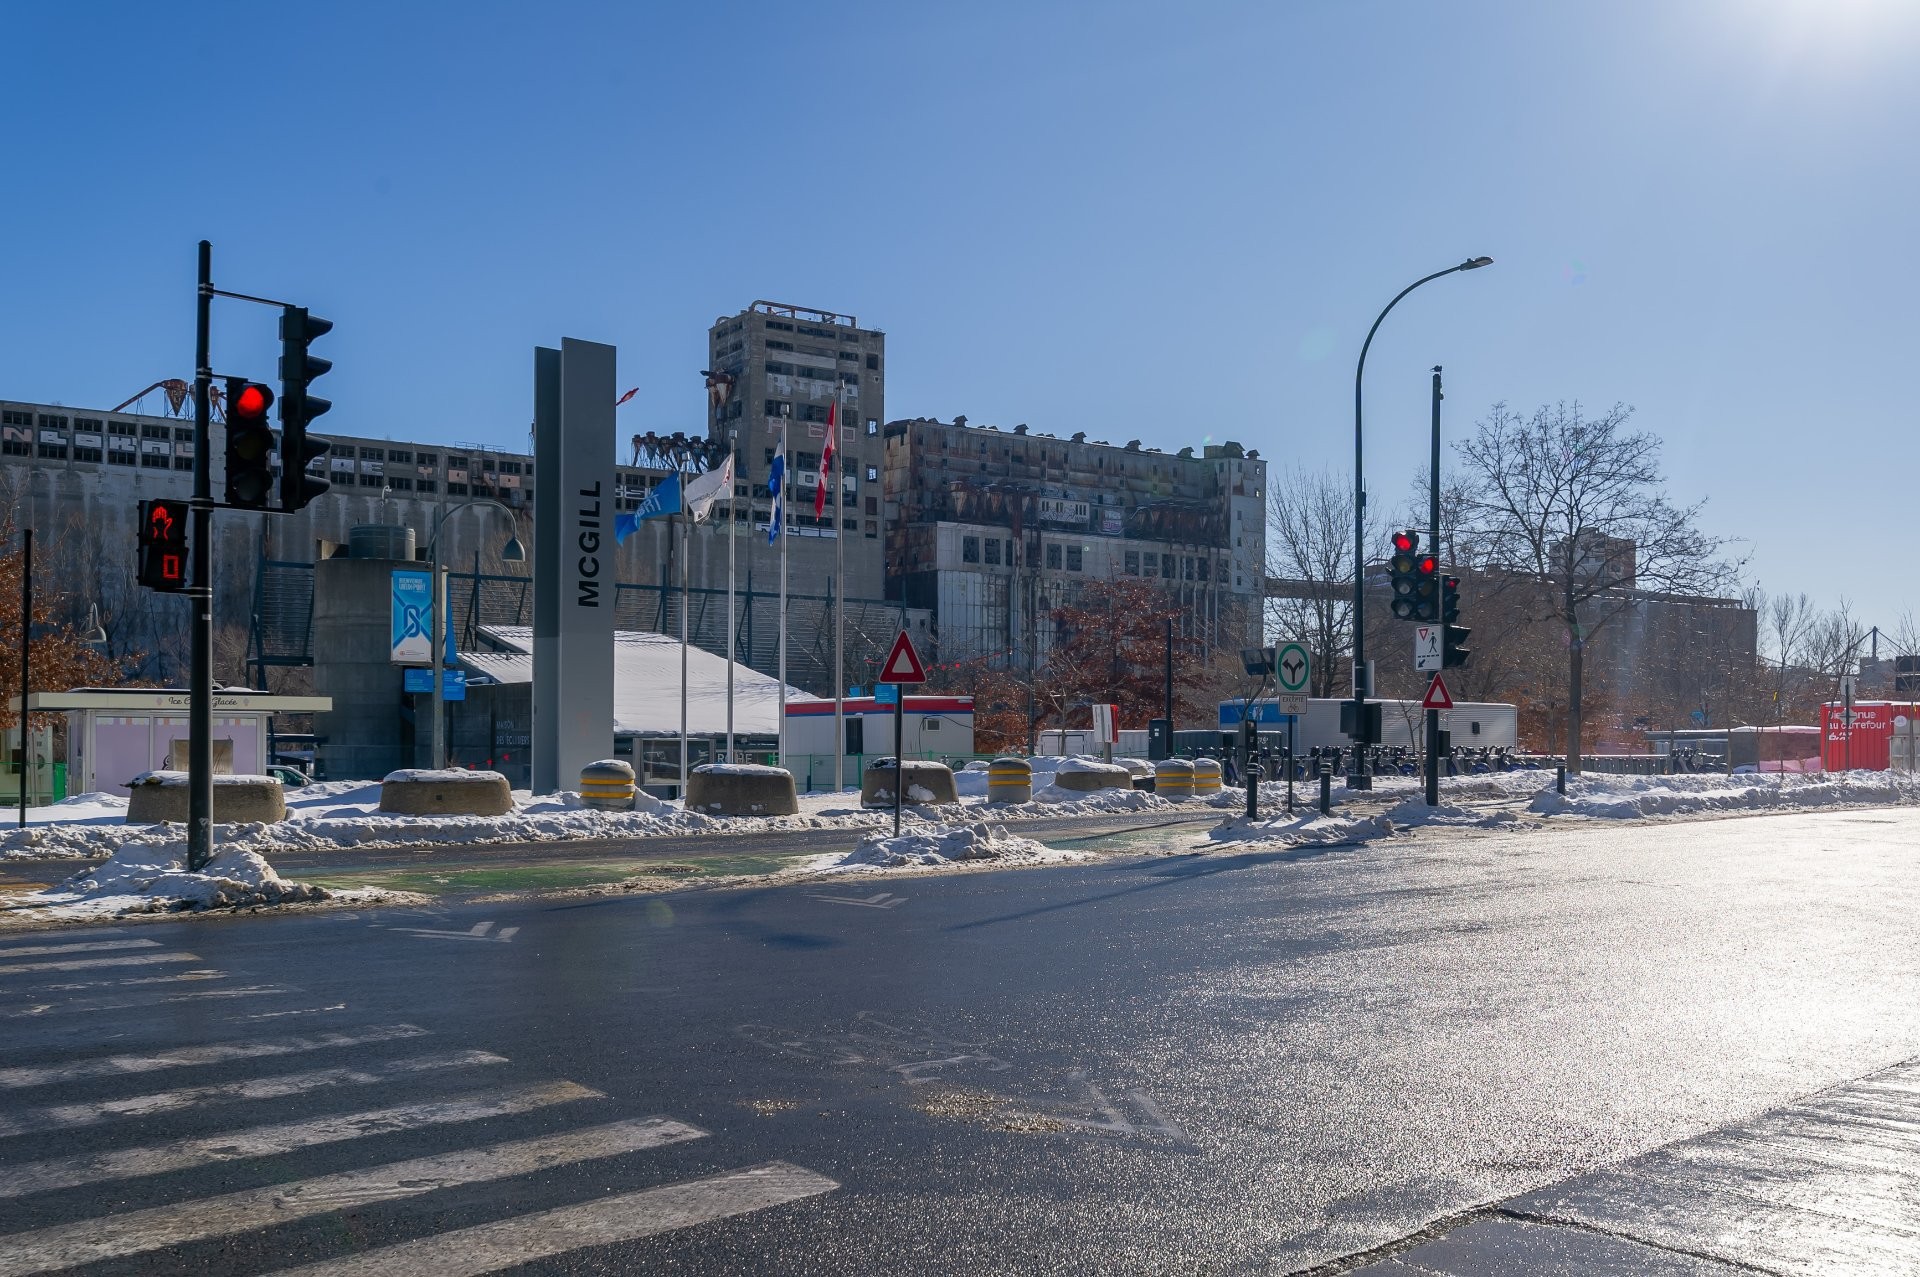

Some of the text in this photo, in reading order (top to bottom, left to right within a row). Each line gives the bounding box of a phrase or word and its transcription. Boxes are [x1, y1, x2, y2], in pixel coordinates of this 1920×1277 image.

[578, 481, 600, 607] MCGILL
[163, 554, 179, 578] 0
[168, 696, 183, 705] Ice
